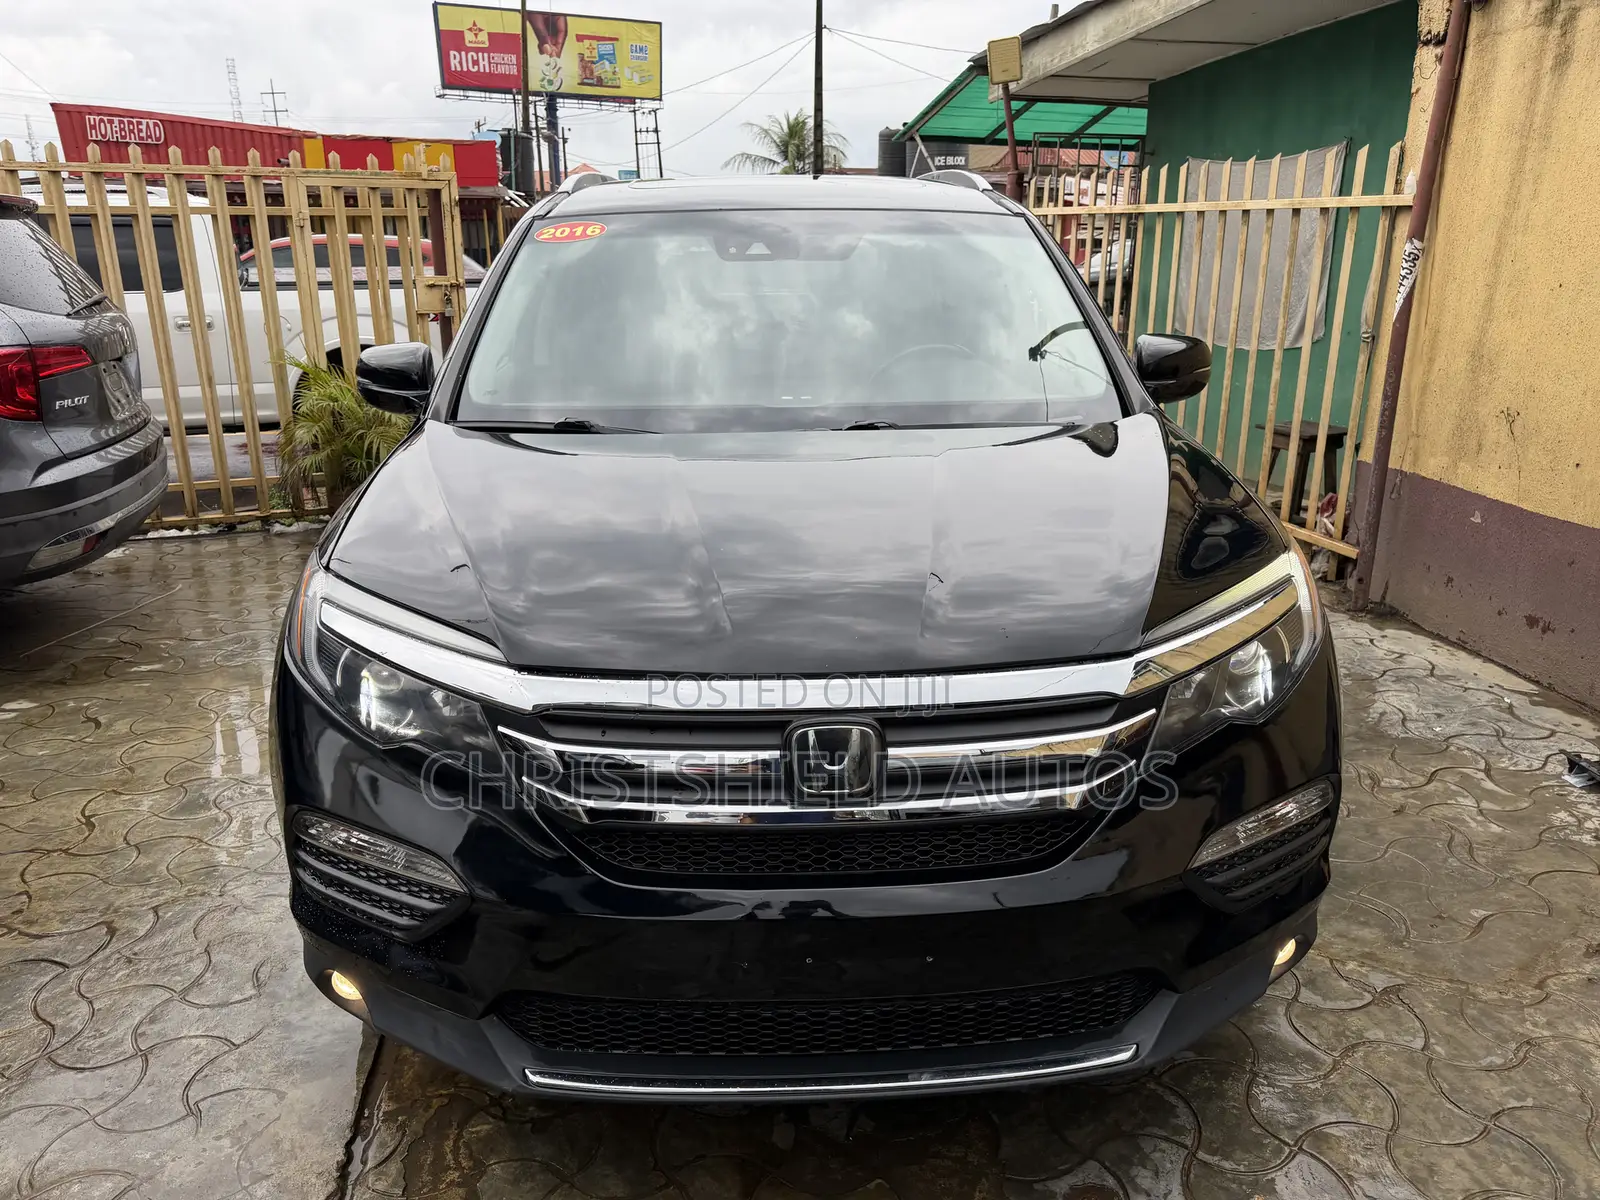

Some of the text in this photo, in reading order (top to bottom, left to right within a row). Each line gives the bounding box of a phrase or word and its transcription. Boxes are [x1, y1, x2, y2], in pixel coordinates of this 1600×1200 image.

[449, 50, 490, 73] RICH
[490, 53, 517, 64] CHICKEN
[490, 63, 518, 75] FLAVOUR
[934, 156, 966, 166] ICE BLOCK
[538, 225, 603, 239] 2016
[55, 395, 90, 410] PILOT
